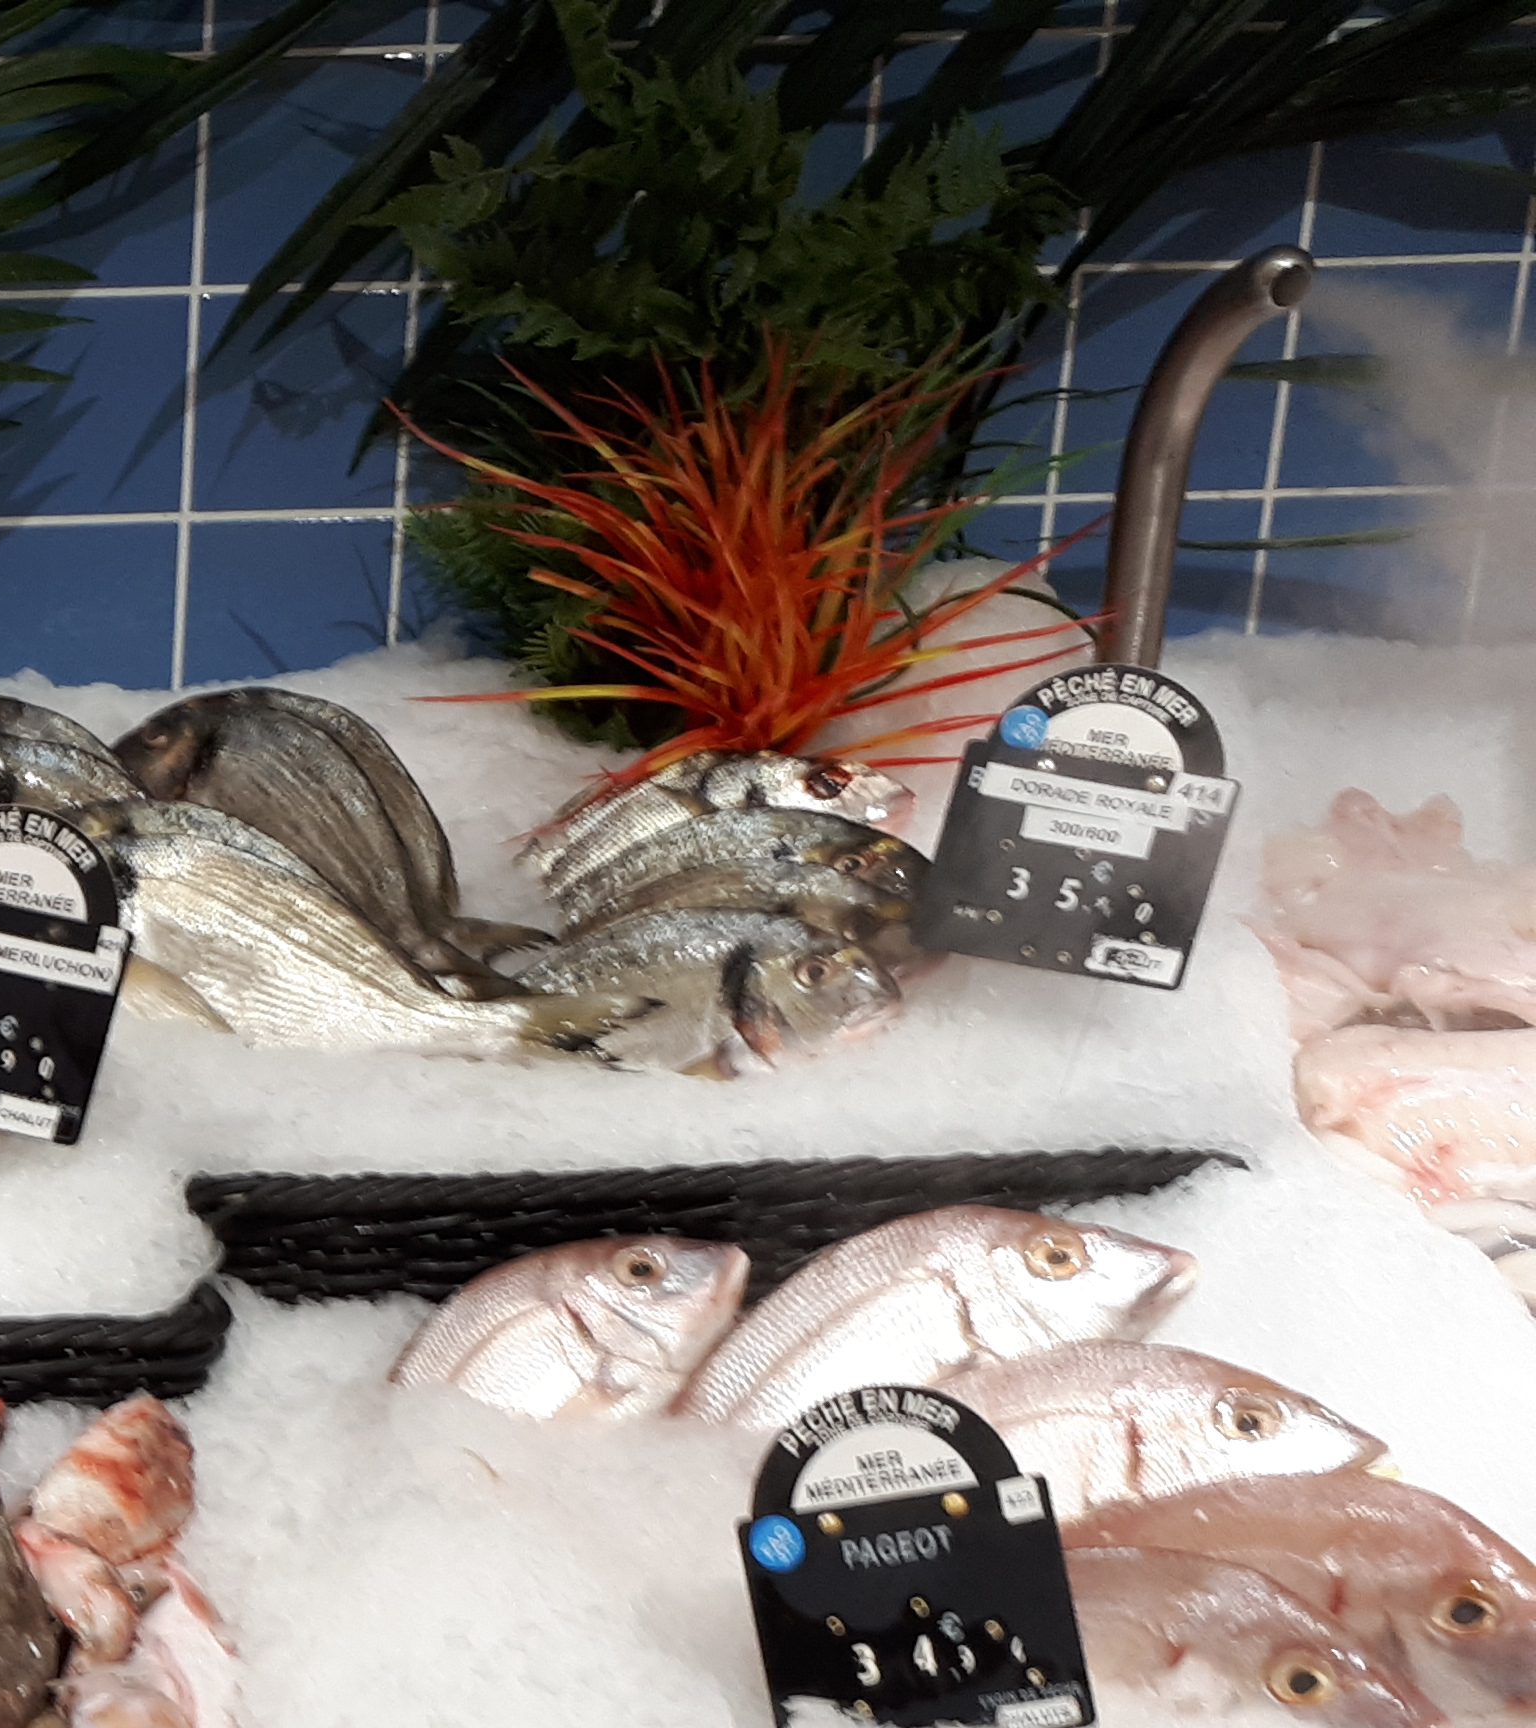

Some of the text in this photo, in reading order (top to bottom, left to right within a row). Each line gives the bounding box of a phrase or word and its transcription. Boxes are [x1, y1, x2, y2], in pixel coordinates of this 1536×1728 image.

[1120, 673, 1156, 698] EN
[1152, 685, 1200, 728] MER
[1087, 728, 1130, 748] MER
[1010, 778, 1091, 807] DORADE
[1097, 795, 1171, 818] ROYALE
[1177, 781, 1220, 806] 414
[25, 813, 58, 841] EN
[54, 827, 98, 874] MER
[0, 1107, 52, 1128] CHALUT
[861, 1388, 898, 1415] EN
[901, 1391, 960, 1433] MER
[805, 1458, 961, 1503] MÉDITERRANÉE
[856, 1450, 903, 1472] MER
[840, 1525, 953, 1571] PAGEOT
